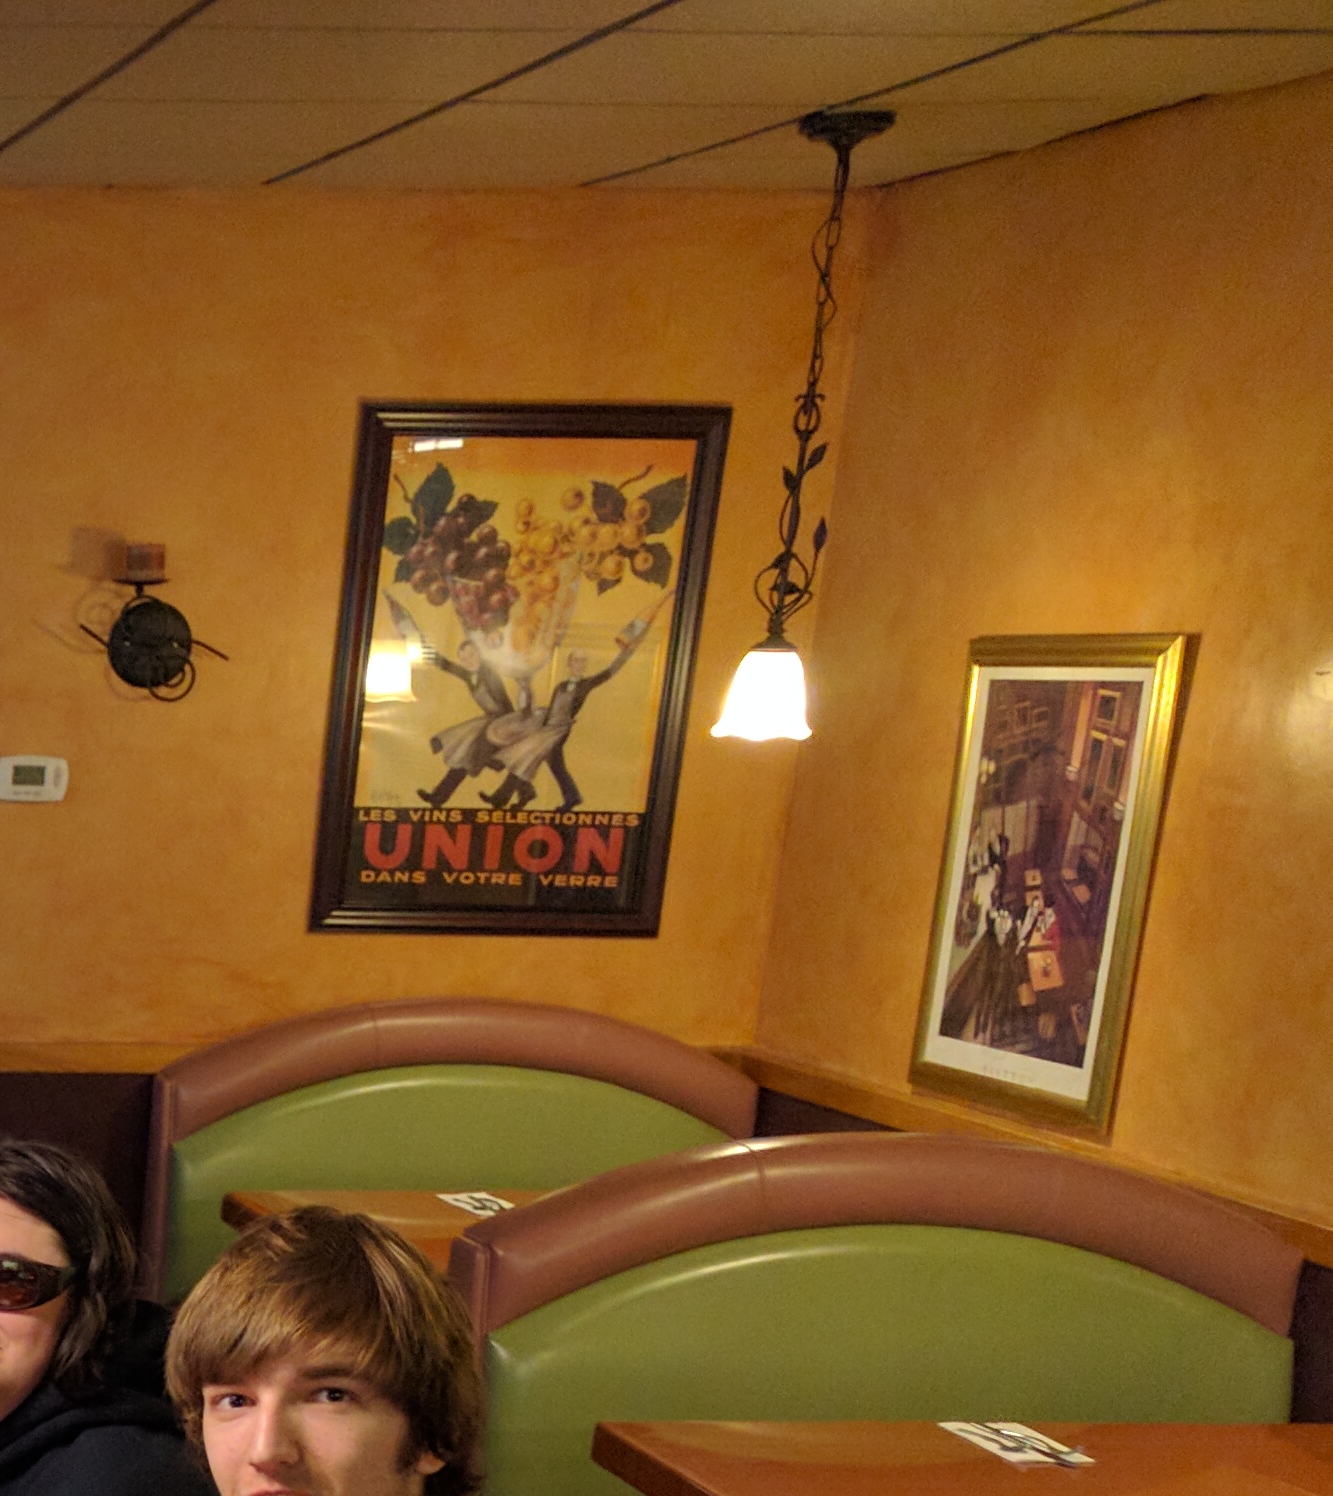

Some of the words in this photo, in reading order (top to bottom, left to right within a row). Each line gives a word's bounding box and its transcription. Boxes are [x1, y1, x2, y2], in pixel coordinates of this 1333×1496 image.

[358, 809, 397, 822] LES
[409, 810, 464, 823] VINS
[363, 822, 625, 874] UNION
[360, 870, 427, 884] DANS
[442, 872, 524, 886] VOTRE
[538, 874, 619, 888] VERRE
